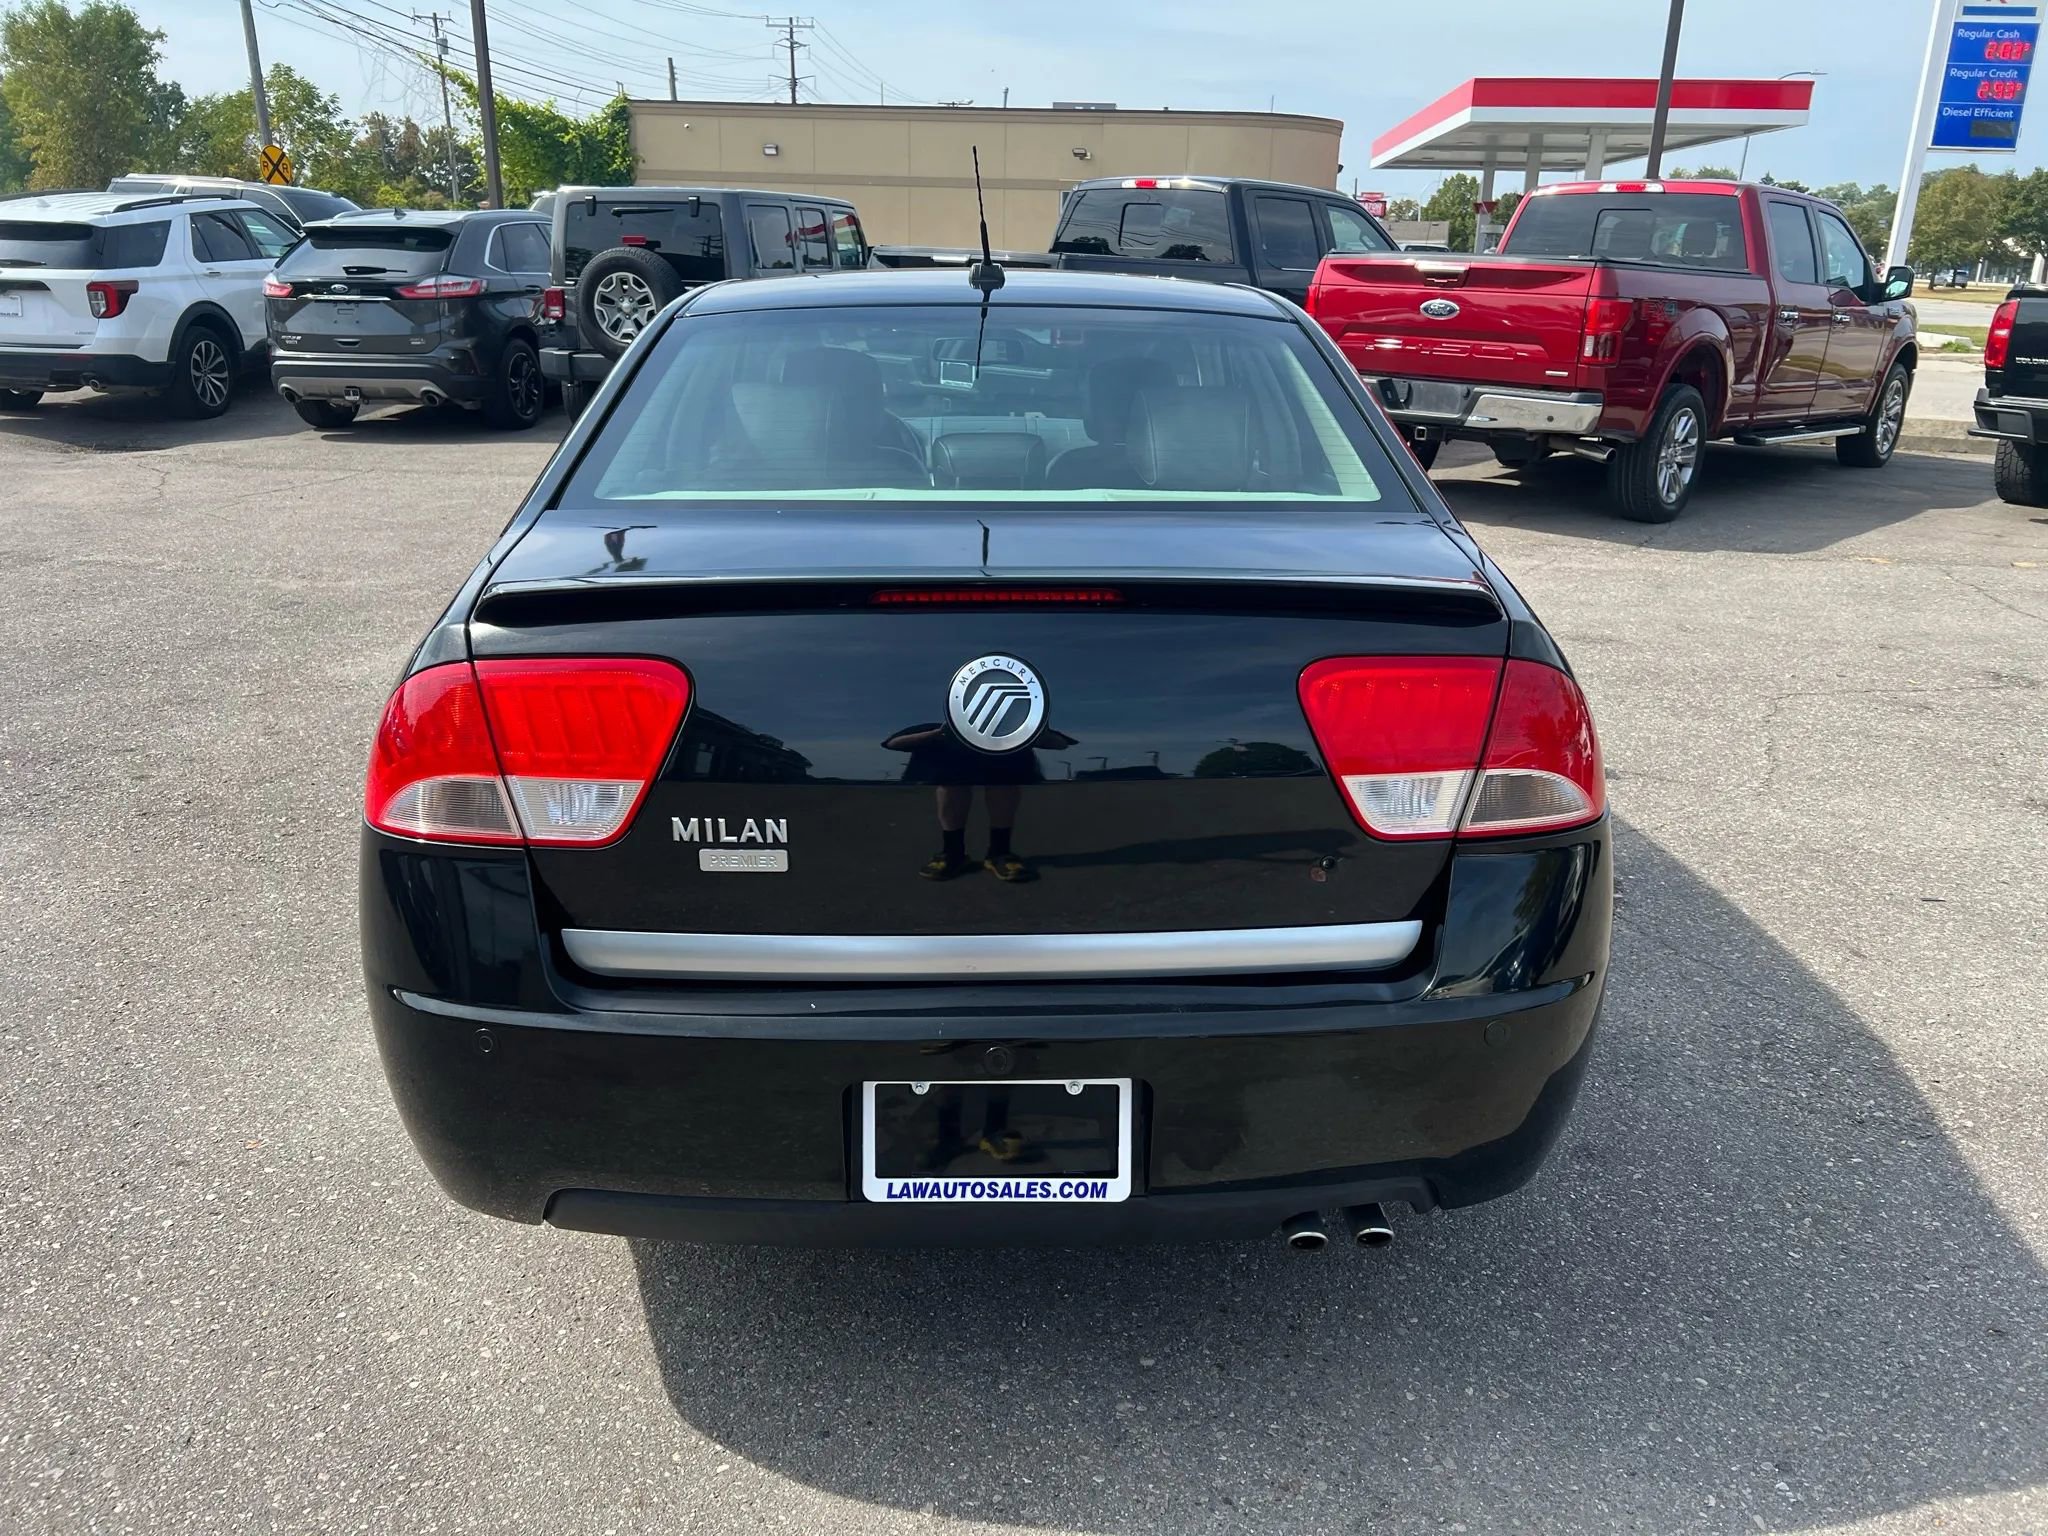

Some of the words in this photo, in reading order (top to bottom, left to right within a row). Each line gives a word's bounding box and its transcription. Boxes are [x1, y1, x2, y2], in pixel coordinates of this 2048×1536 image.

[1957, 28, 1995, 40] Regular
[1996, 29, 2020, 39] Cash
[1950, 67, 1987, 79] Regular
[1989, 68, 2018, 78] Credit
[1942, 107, 1972, 117] Diesel
[1974, 108, 2014, 118] Efficient
[262, 161, 270, 172] R
[281, 163, 290, 174] R
[959, 658, 1035, 686] MERCURY
[671, 817, 788, 843] MILAN
[709, 854, 778, 868] PREMIER
[886, 1181, 1108, 1199] LAWAUTOSALES.COM
